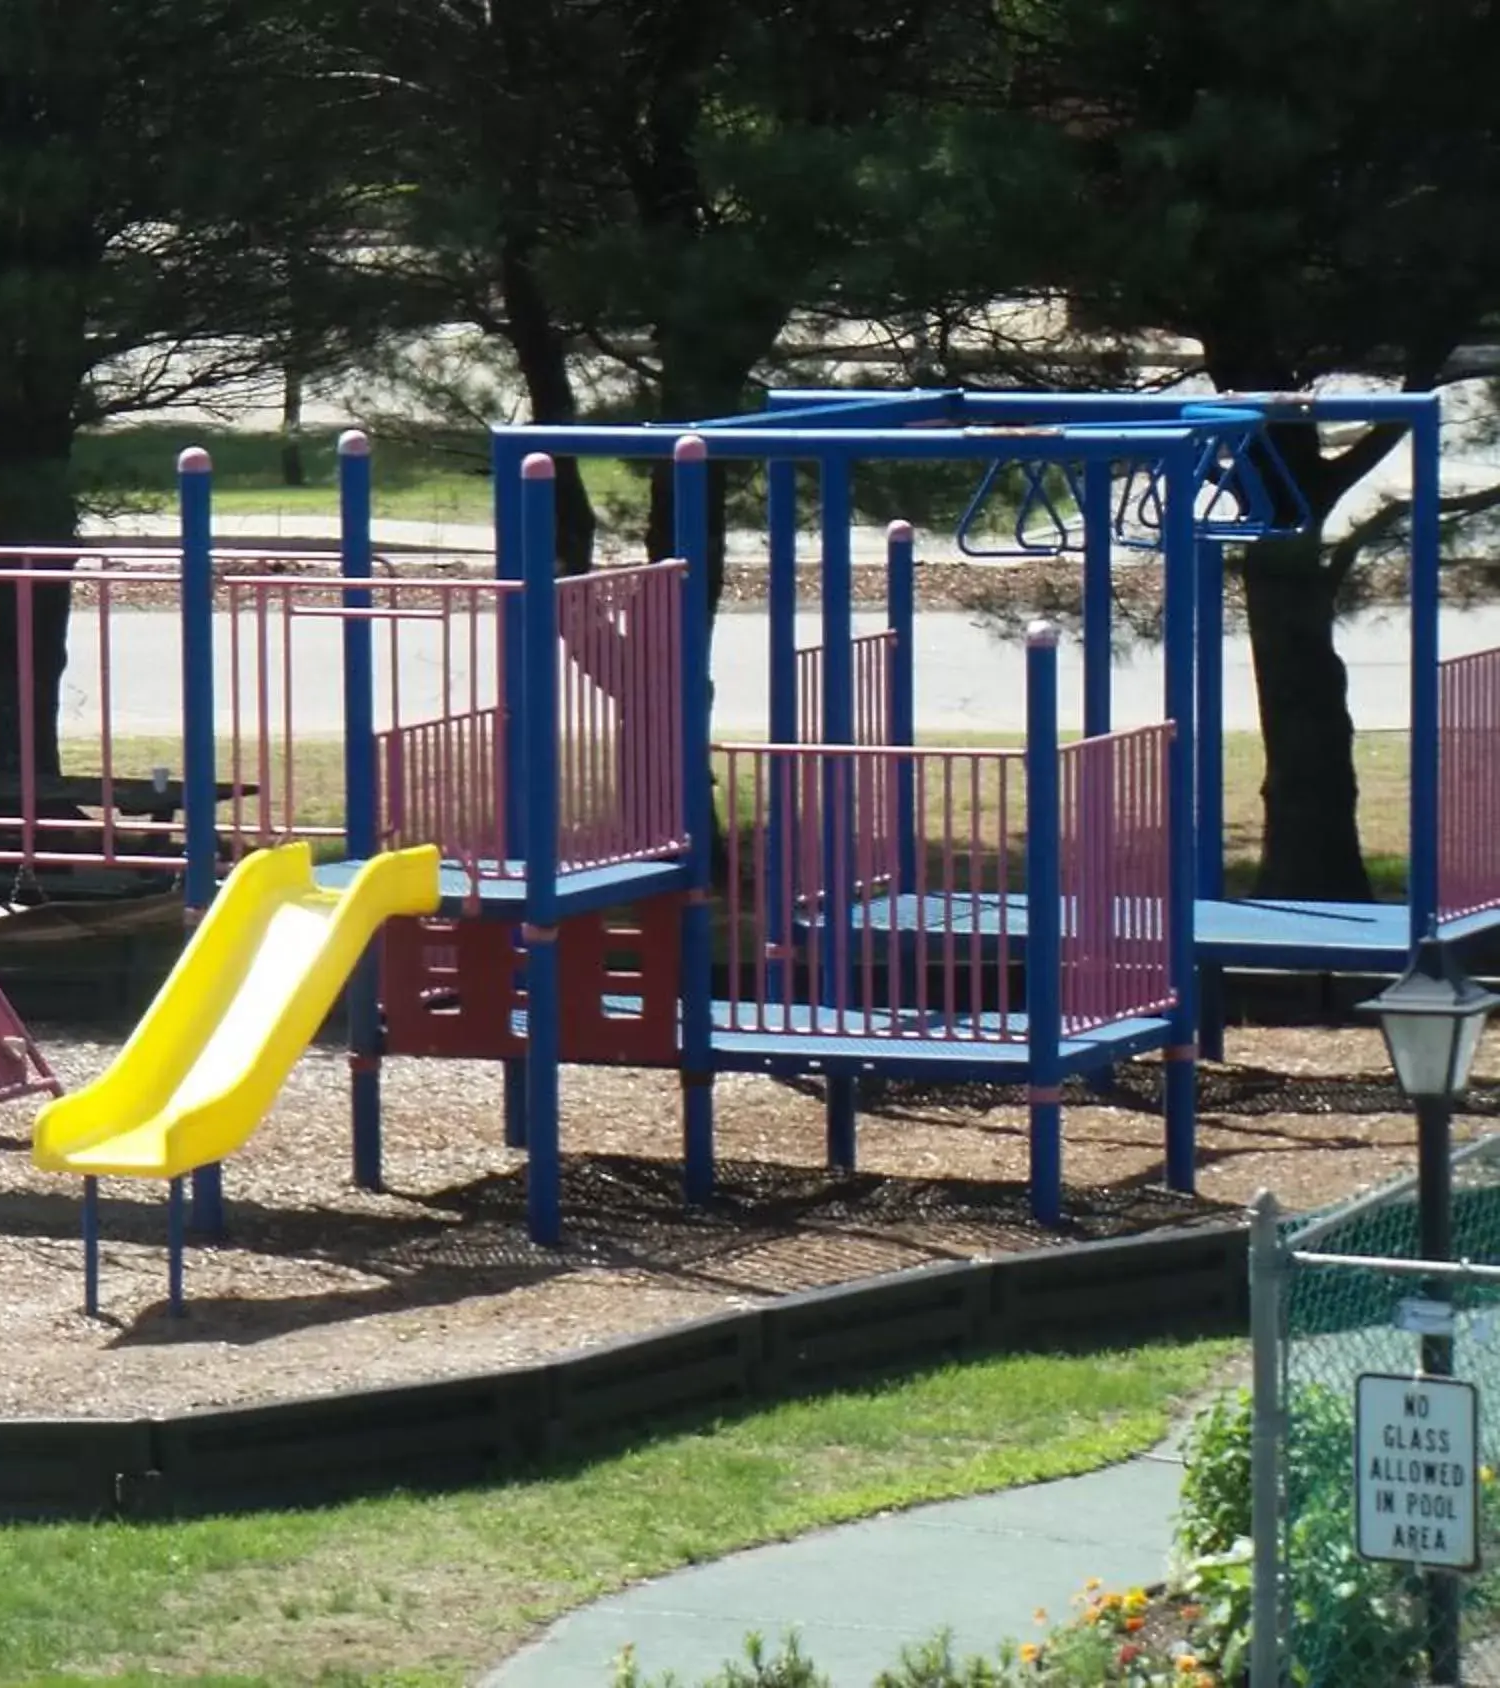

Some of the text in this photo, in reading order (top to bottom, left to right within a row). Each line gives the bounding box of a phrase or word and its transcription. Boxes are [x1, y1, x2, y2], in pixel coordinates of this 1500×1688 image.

[1403, 1392, 1430, 1418] NO
[1383, 1424, 1450, 1453] GLASS
[1369, 1456, 1465, 1487] ALLOWED
[1376, 1489, 1457, 1520] IN POOL
[1392, 1524, 1447, 1551] AREA
